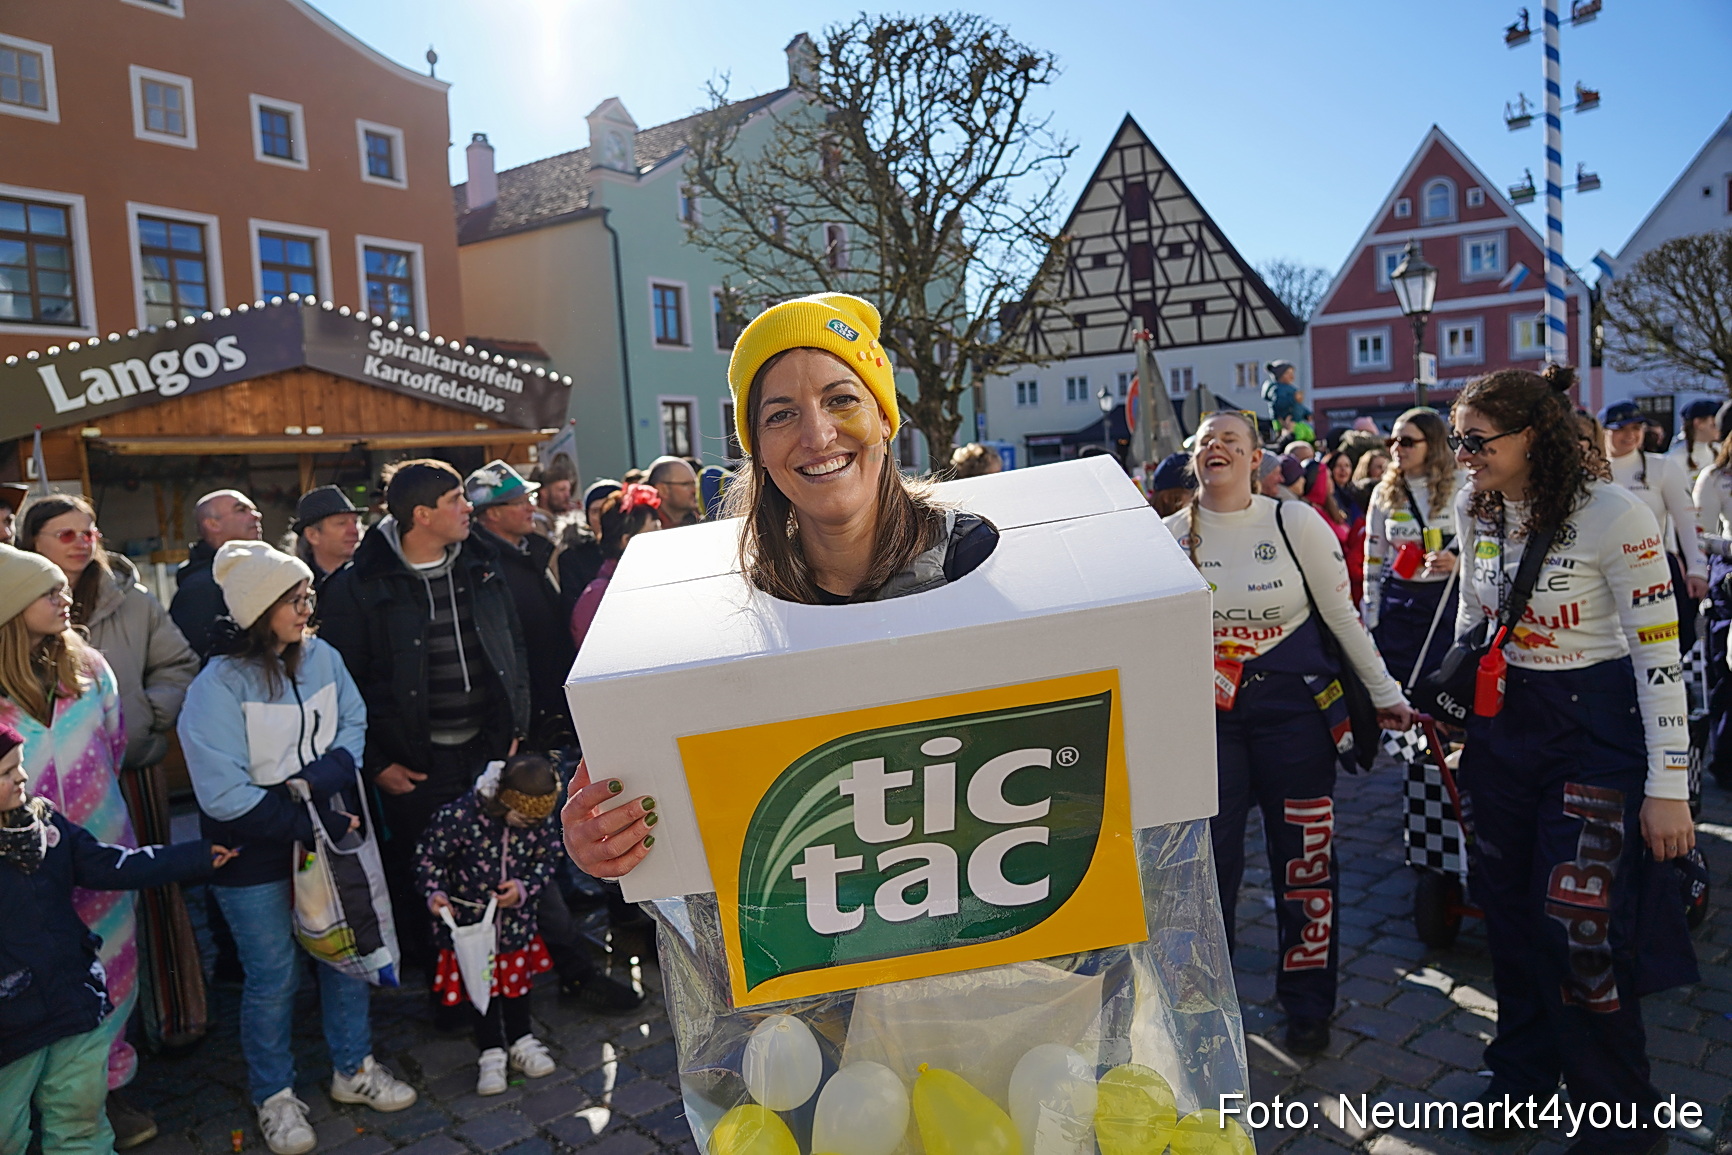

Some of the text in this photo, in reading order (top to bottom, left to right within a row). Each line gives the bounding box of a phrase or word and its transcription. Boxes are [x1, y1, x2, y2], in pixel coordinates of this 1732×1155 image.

[37, 334, 247, 414] Langos
[363, 354, 506, 413] Kartoffelchips
[367, 329, 524, 393] Spiralkartoffeln
[1213, 606, 1281, 621] ACLE
[1247, 582, 1273, 592] Mobil
[1533, 650, 1586, 665] DRINK
[1671, 756, 1687, 764] VIS
[839, 736, 1052, 844] tic
[792, 826, 1049, 934] tac
